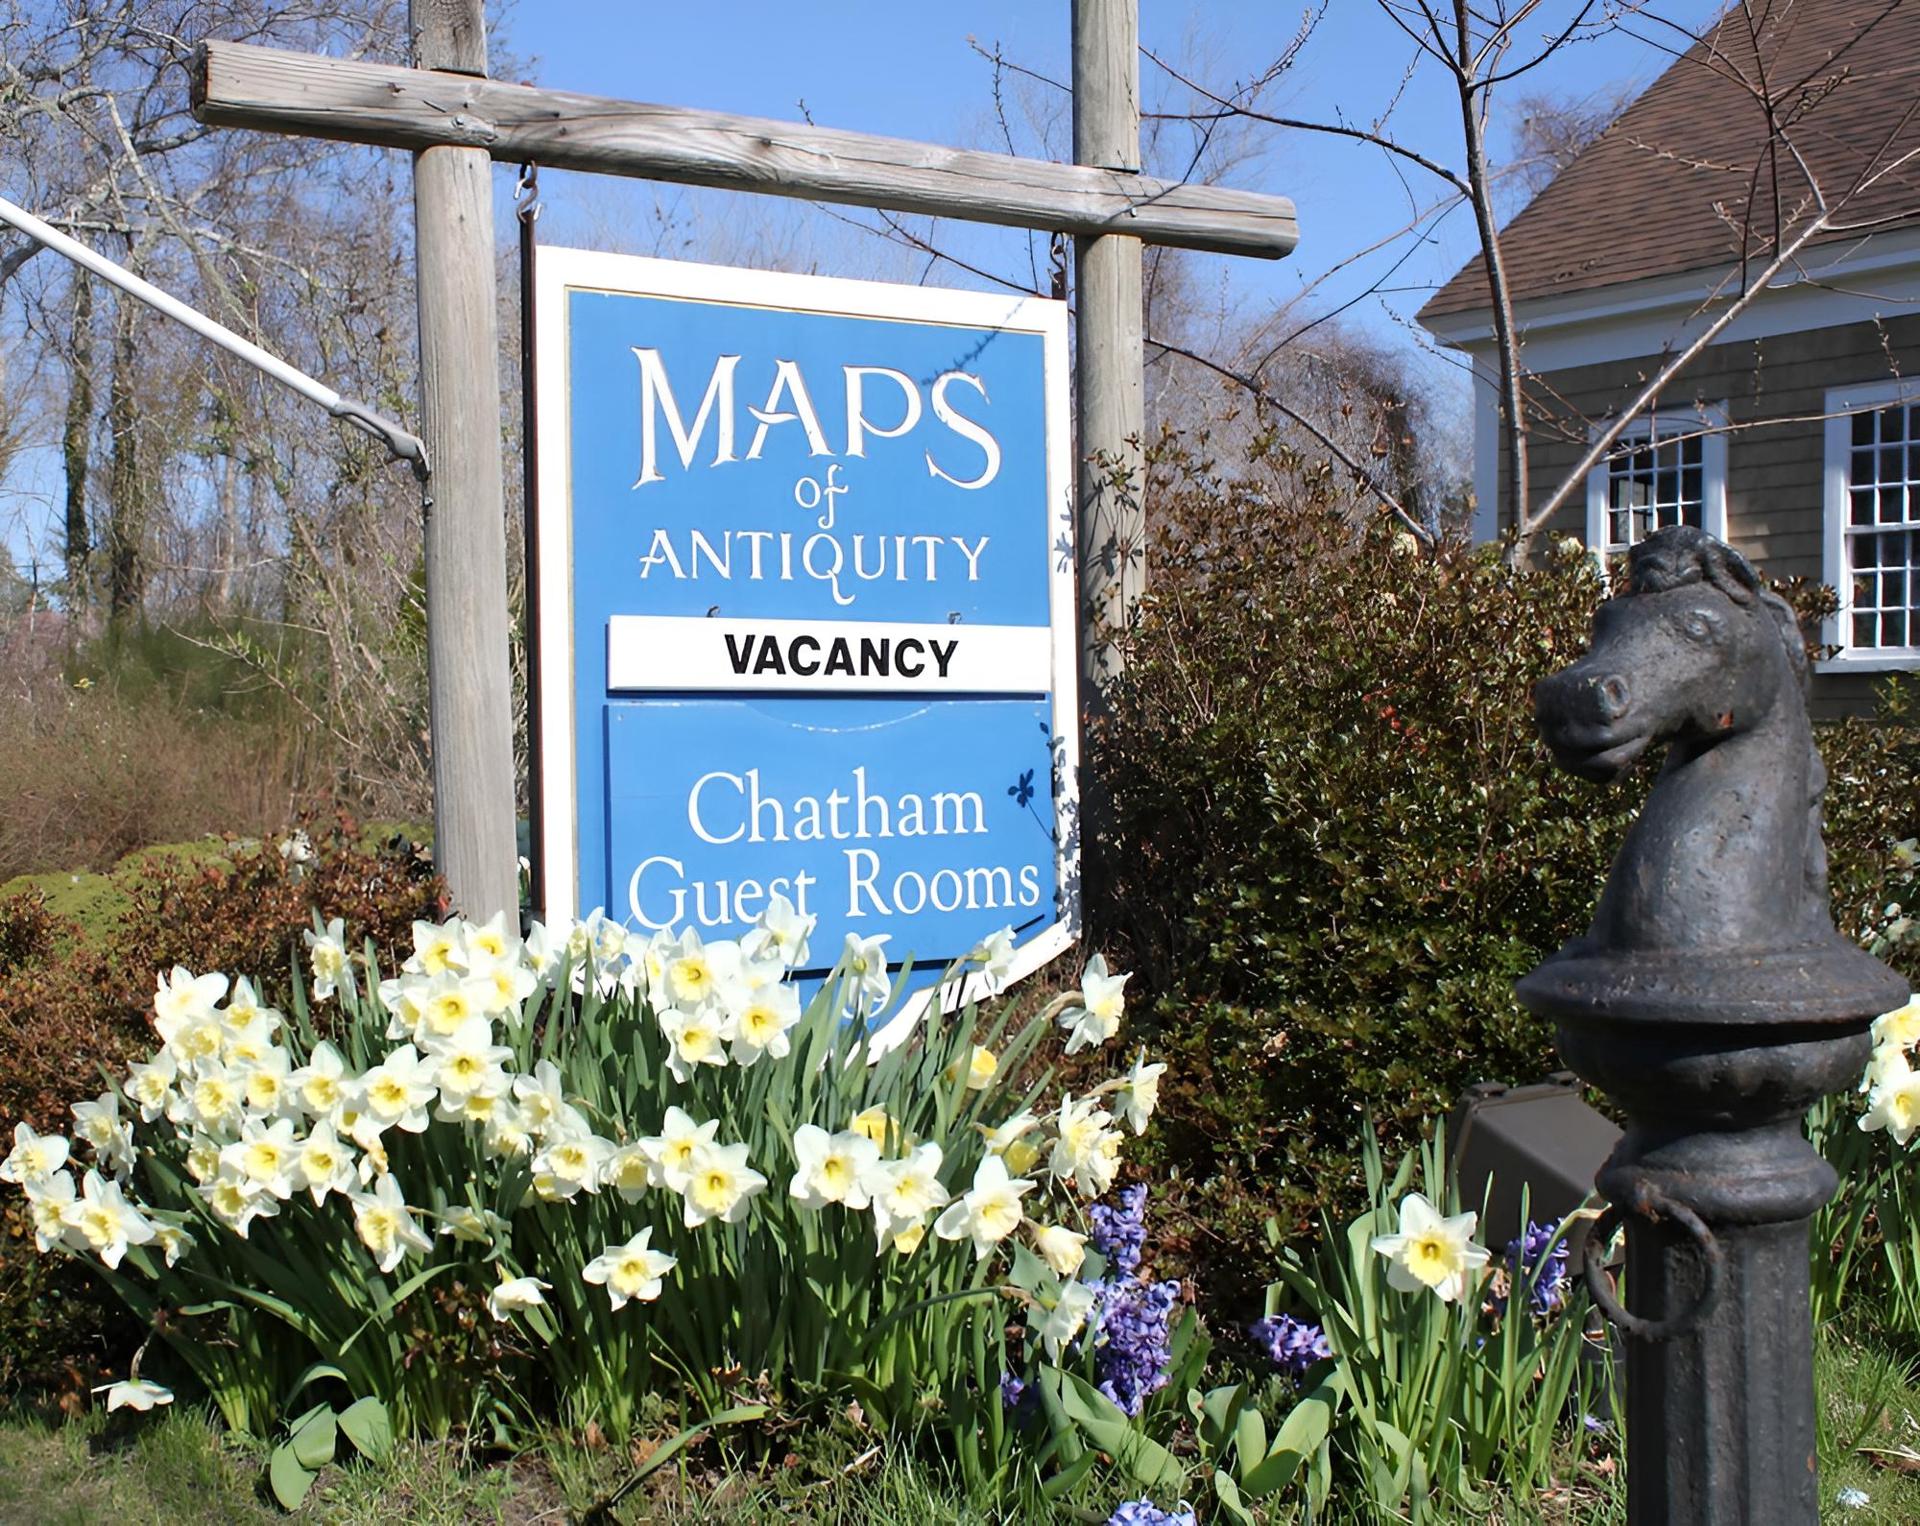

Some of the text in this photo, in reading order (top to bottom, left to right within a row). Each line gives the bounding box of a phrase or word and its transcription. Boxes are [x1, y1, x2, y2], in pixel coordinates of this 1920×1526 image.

[630, 346, 1001, 490] MAPS
[794, 463, 849, 530] of
[639, 529, 990, 606] ANTIQUITY
[724, 634, 959, 678] VACANCY
[688, 766, 988, 844] Chatham
[843, 848, 1040, 917] Rooms
